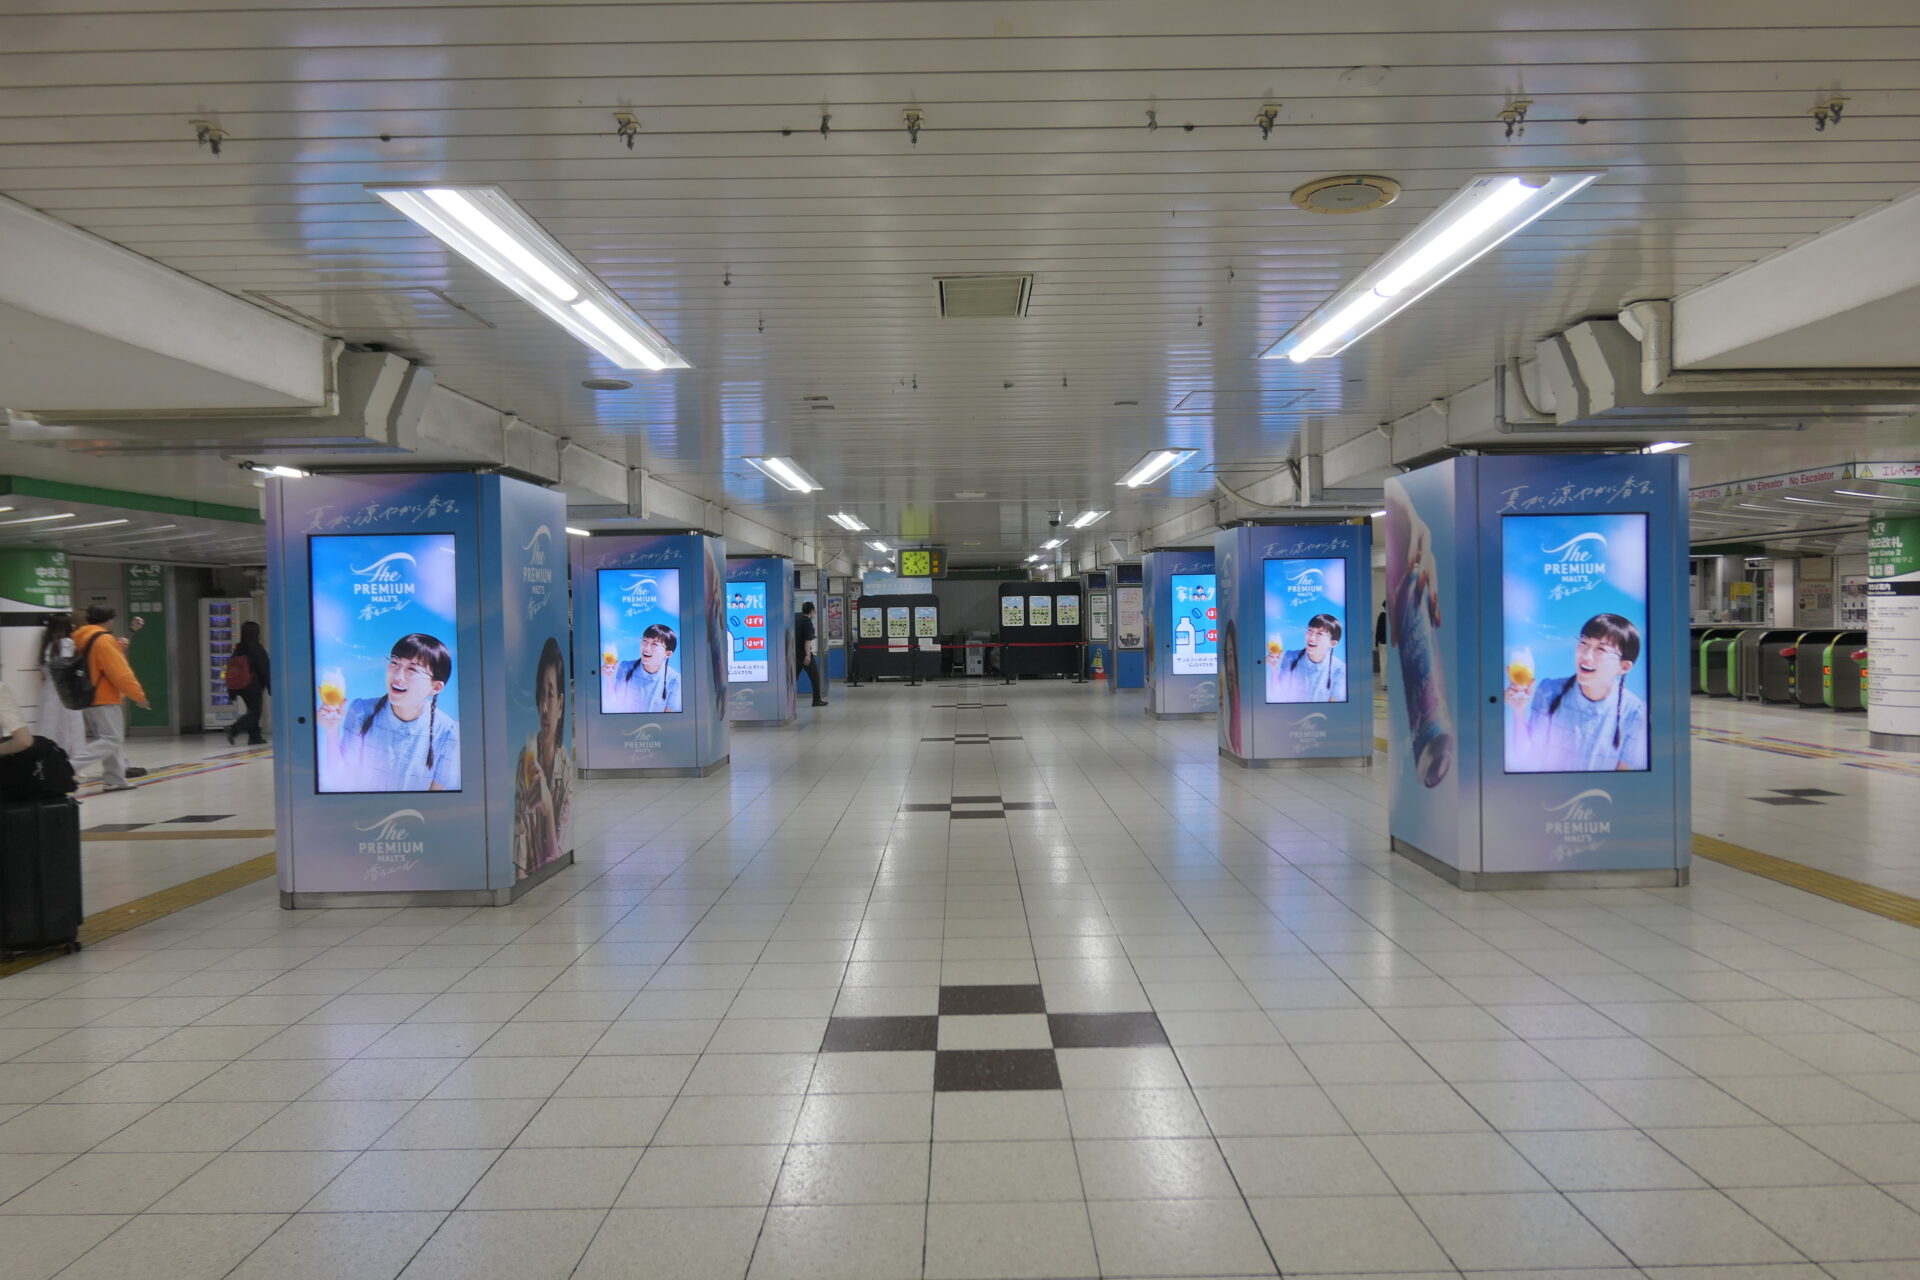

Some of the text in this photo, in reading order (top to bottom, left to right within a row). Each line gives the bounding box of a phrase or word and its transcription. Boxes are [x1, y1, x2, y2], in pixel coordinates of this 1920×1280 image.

[1789, 471, 1835, 486] No Escalator
[1747, 479, 1784, 492] No Elevator
[1872, 522, 1886, 533] JR
[1544, 563, 1606, 575] PREMIUM
[1561, 575, 1588, 583] MALT'S
[354, 583, 415, 595] PREMIUM
[371, 595, 398, 603] MALT'S
[622, 595, 657, 603] PREMIUM
[624, 741, 661, 749] PREMIUM
[1545, 821, 1611, 834] PREMIUM
[359, 841, 424, 854] PREMIUM
